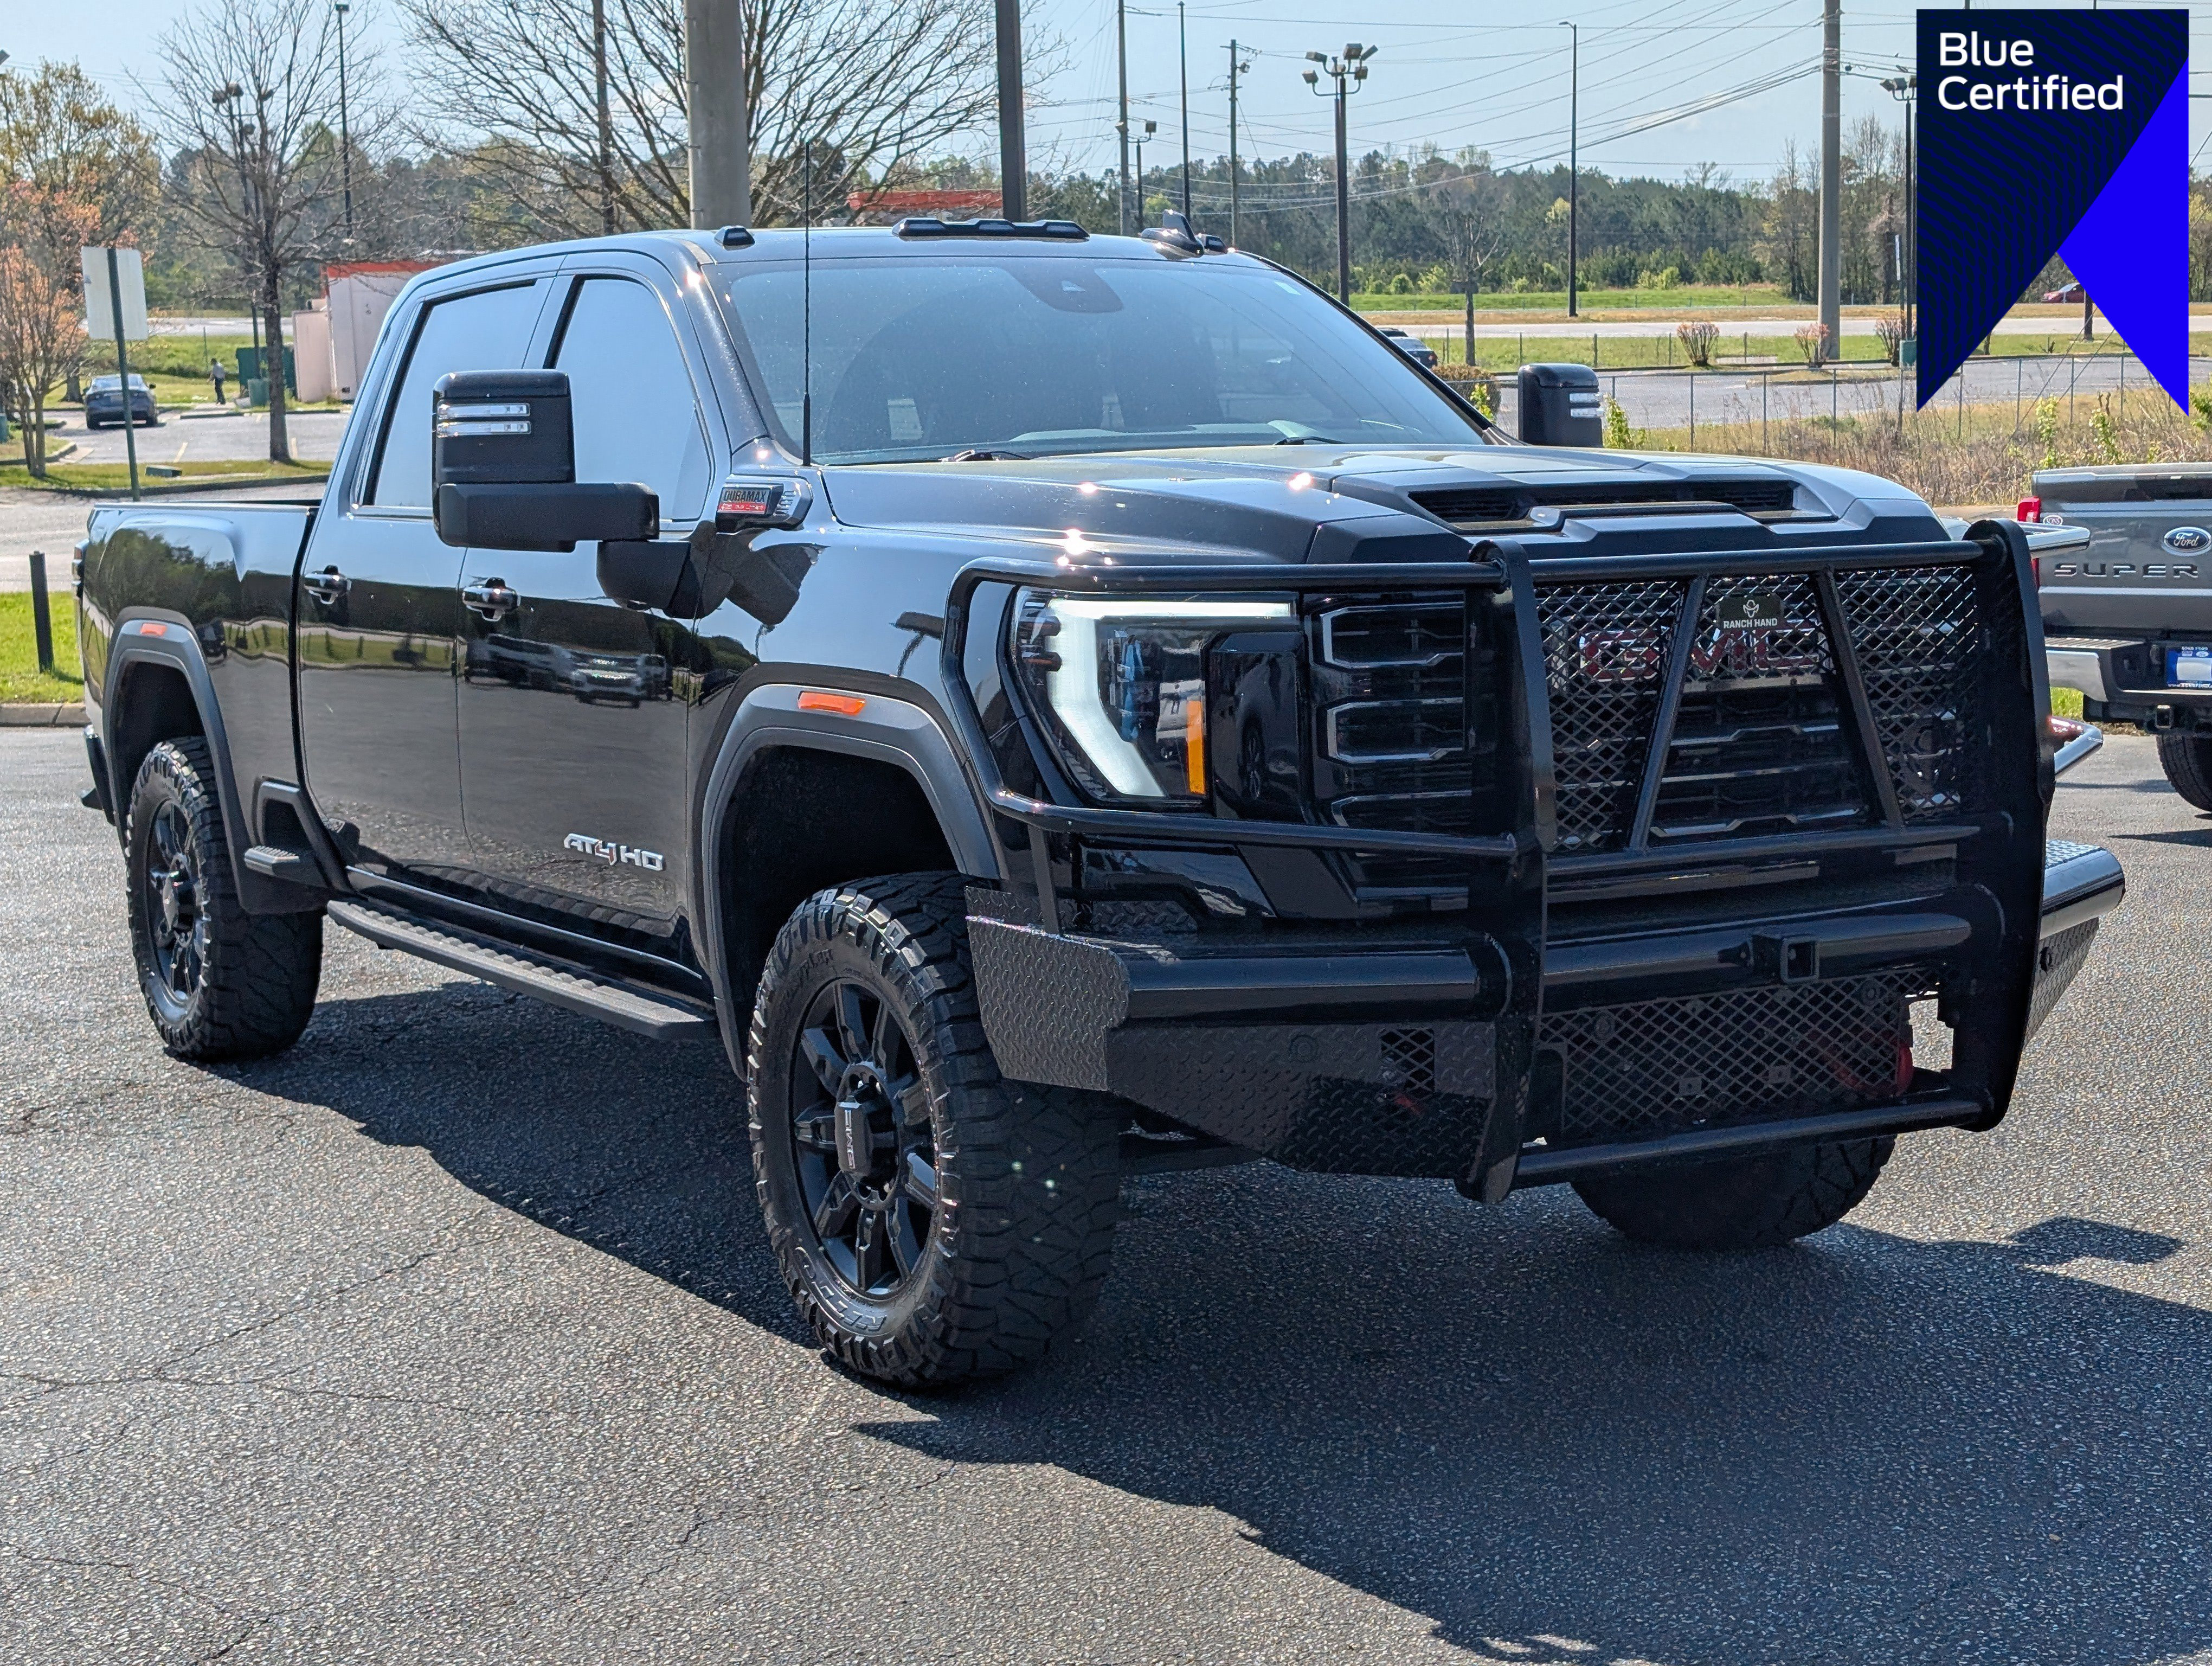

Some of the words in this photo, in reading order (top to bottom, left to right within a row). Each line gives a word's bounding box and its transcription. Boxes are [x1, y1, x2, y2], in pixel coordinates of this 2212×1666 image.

[723, 490, 767, 502] DURAMAX
[2173, 532, 2200, 547] Ford
[2054, 563, 2198, 578] SUPER
[1723, 619, 1753, 629] RANCH
[1754, 618, 1778, 627] HAND
[845, 1110, 856, 1169] GMC
